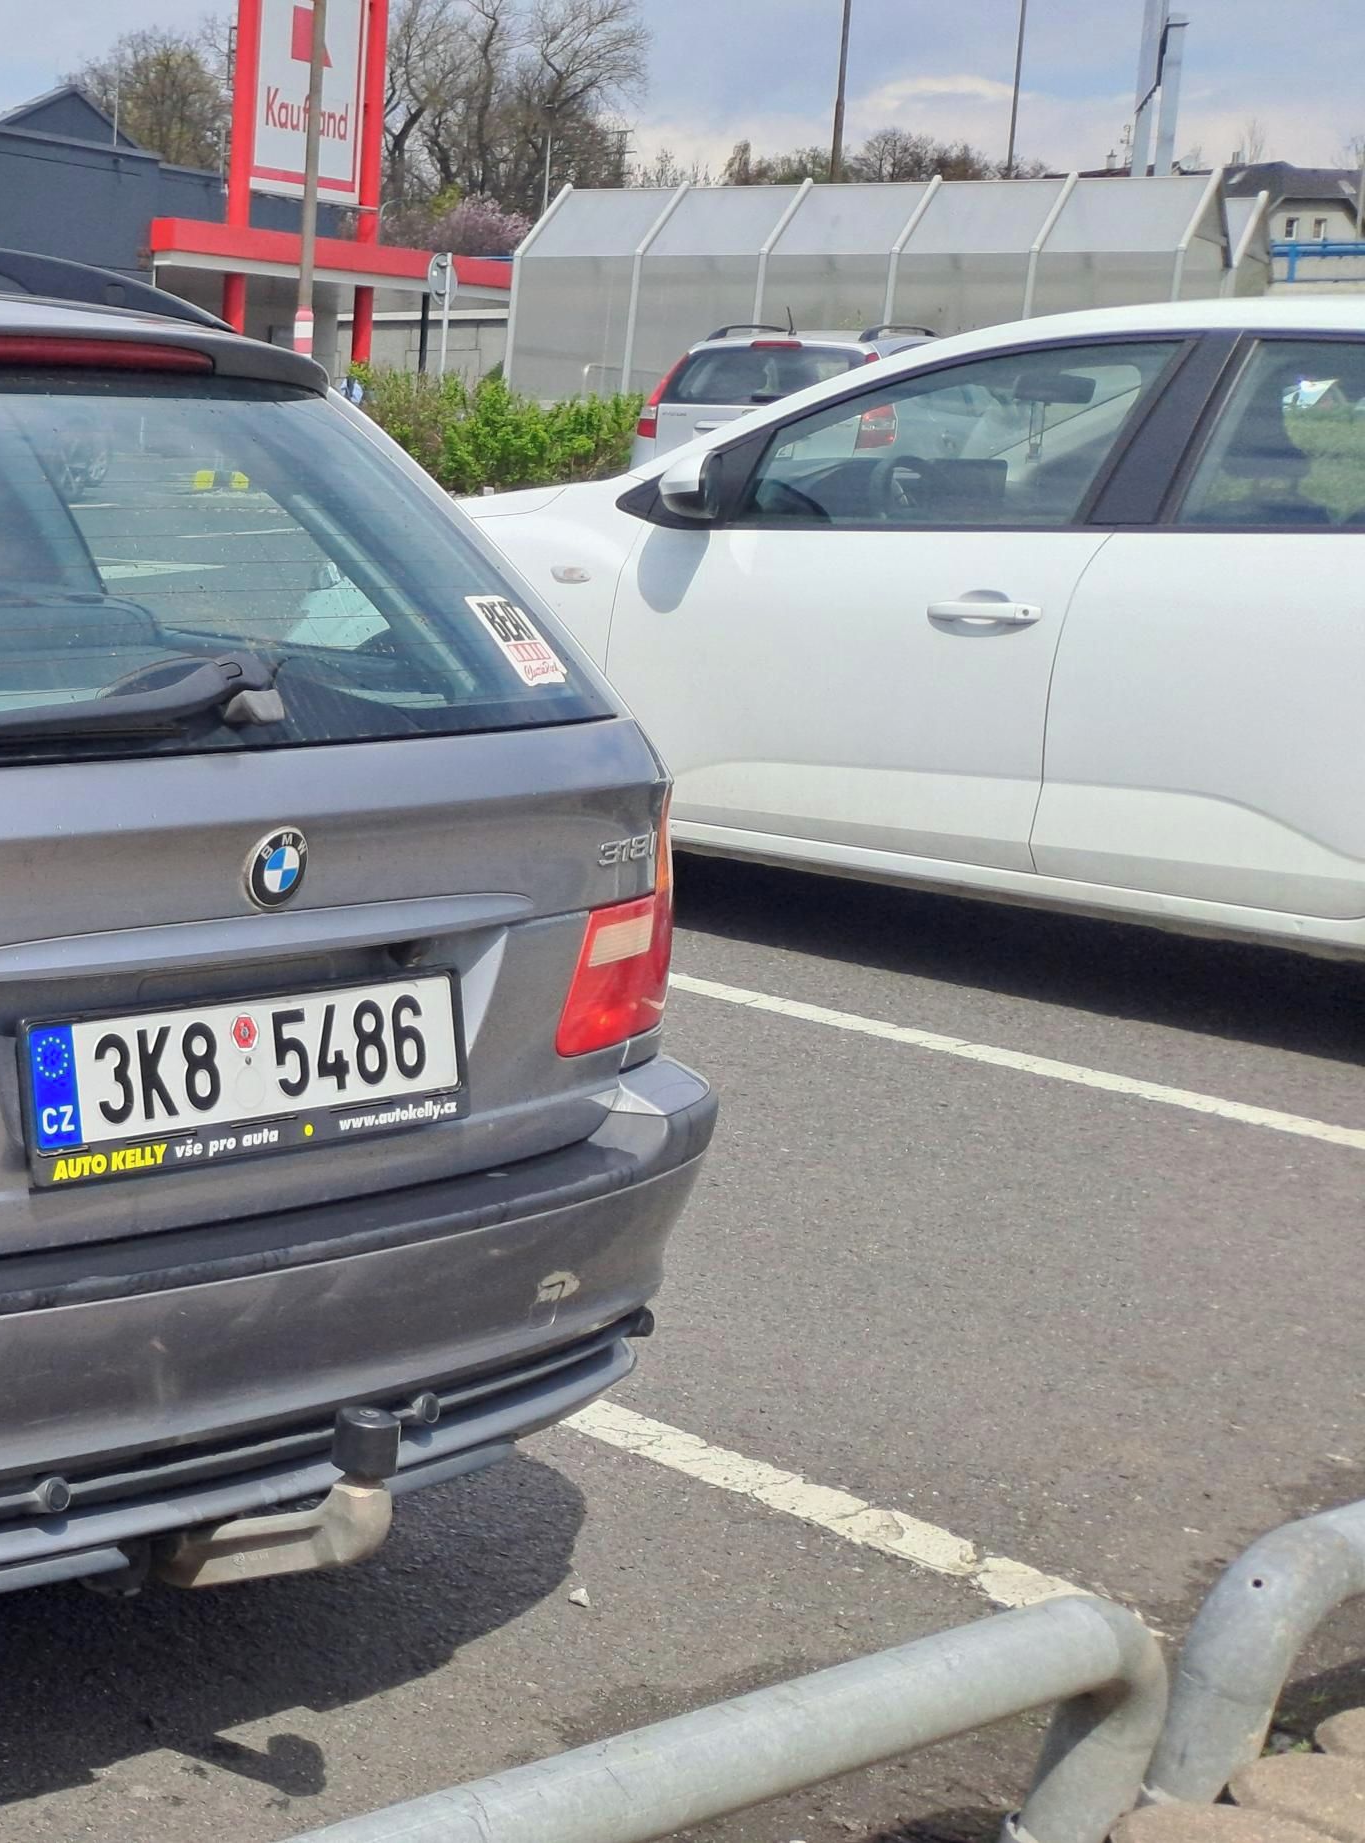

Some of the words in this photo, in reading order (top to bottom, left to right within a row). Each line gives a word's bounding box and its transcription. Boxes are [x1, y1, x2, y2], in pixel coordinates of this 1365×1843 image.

[265, 86, 348, 141] Kaufand
[260, 833, 308, 860] BMW
[93, 1021, 222, 1125] 3K8
[271, 994, 428, 1098] 5486
[42, 1105, 75, 1135] CZ
[53, 1153, 108, 1182] AUTO
[110, 1143, 168, 1172] KELLY
[175, 1139, 203, 1159] vše
[209, 1136, 237, 1157] pro
[242, 1127, 280, 1147] auta
[339, 1100, 457, 1131] www.autokelly.cz
